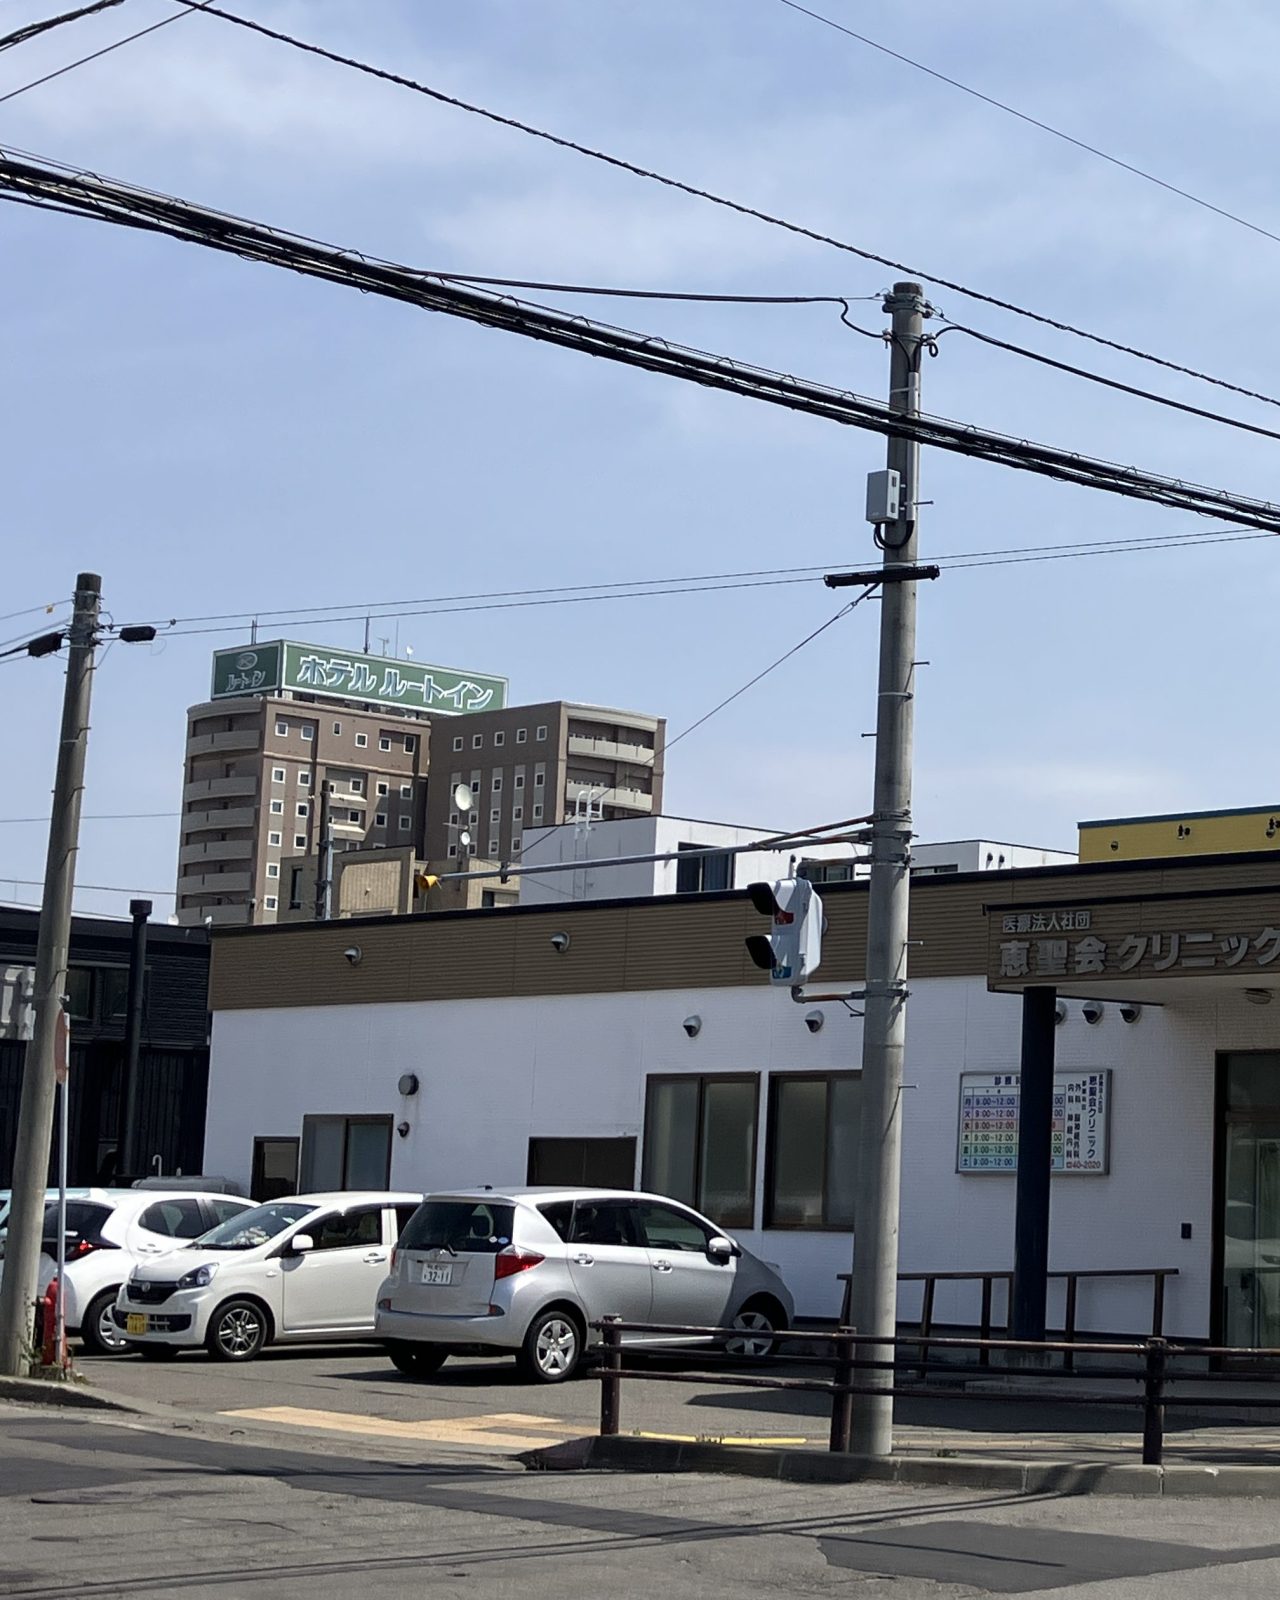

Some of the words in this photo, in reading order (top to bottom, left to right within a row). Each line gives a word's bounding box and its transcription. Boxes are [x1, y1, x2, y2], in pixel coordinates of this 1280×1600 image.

[297, 656, 378, 692] ホテル
[379, 667, 493, 711] ルートイン
[1002, 911, 1091, 933] 医療法人社団
